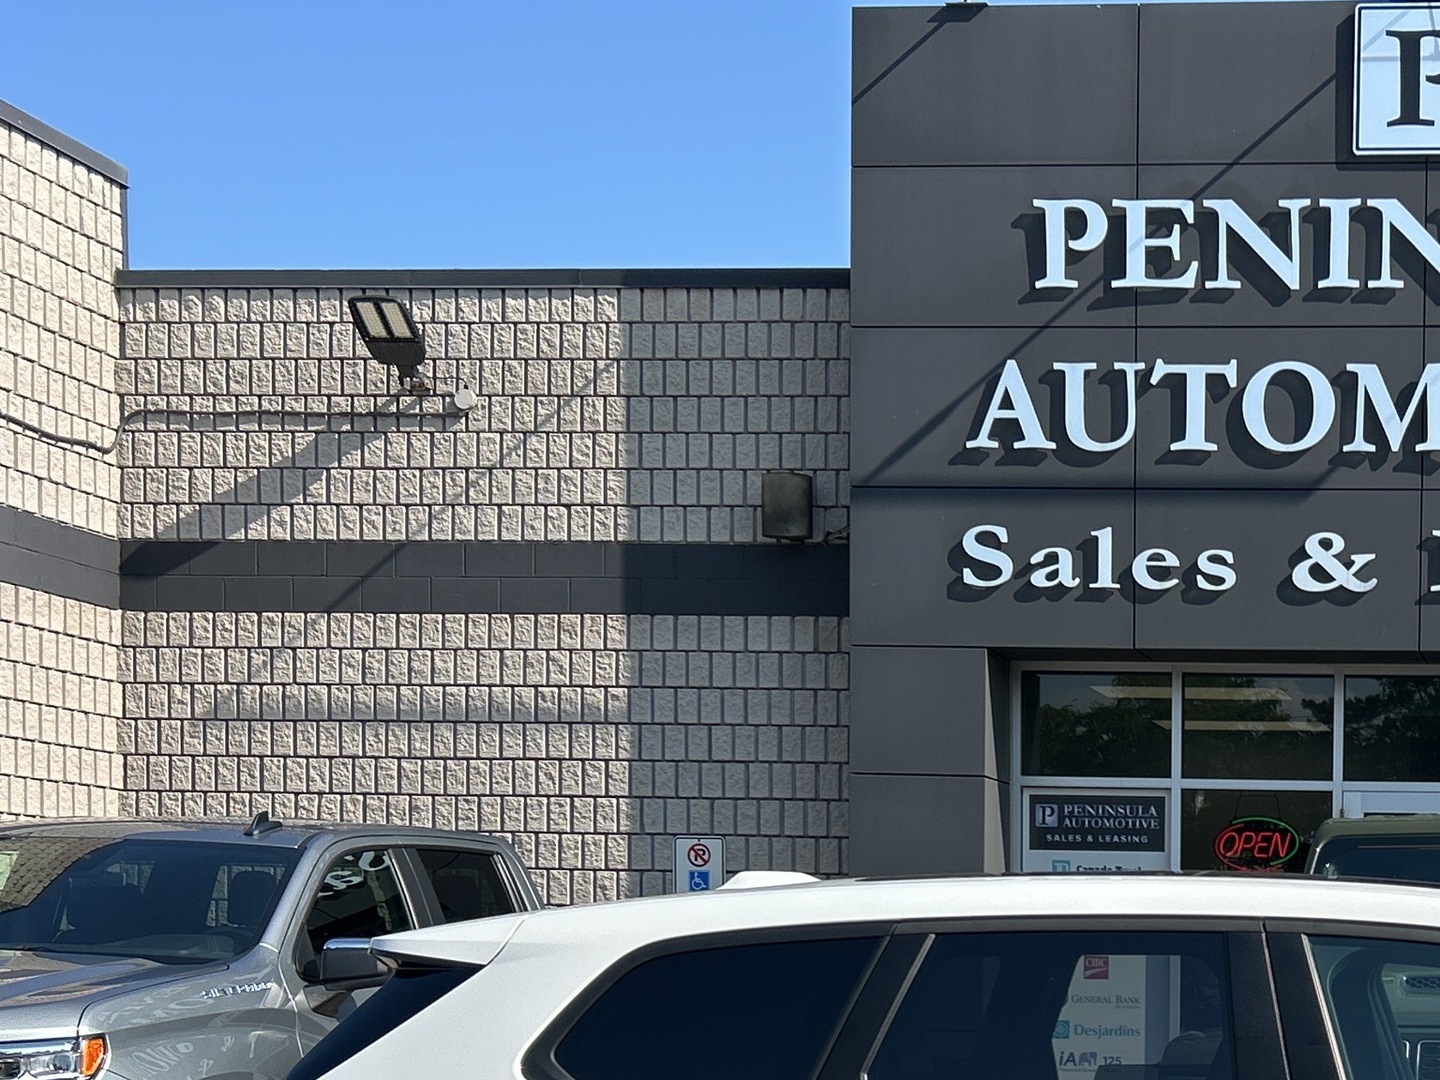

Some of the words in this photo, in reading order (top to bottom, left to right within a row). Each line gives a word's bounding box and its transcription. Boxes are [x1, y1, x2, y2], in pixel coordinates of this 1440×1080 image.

[961, 524, 1237, 592] Sales
[1291, 530, 1378, 594] &
[1063, 804, 1159, 818] PENINSULA
[1062, 817, 1160, 830] AUTOMOTIVE
[1046, 833, 1082, 843] SALES
[1087, 834, 1094, 843] &
[1099, 834, 1149, 844] LEASING
[1219, 831, 1292, 859] OPEN
[1085, 957, 1108, 967] CIBC
[1074, 1024, 1141, 1039] Desjardins
